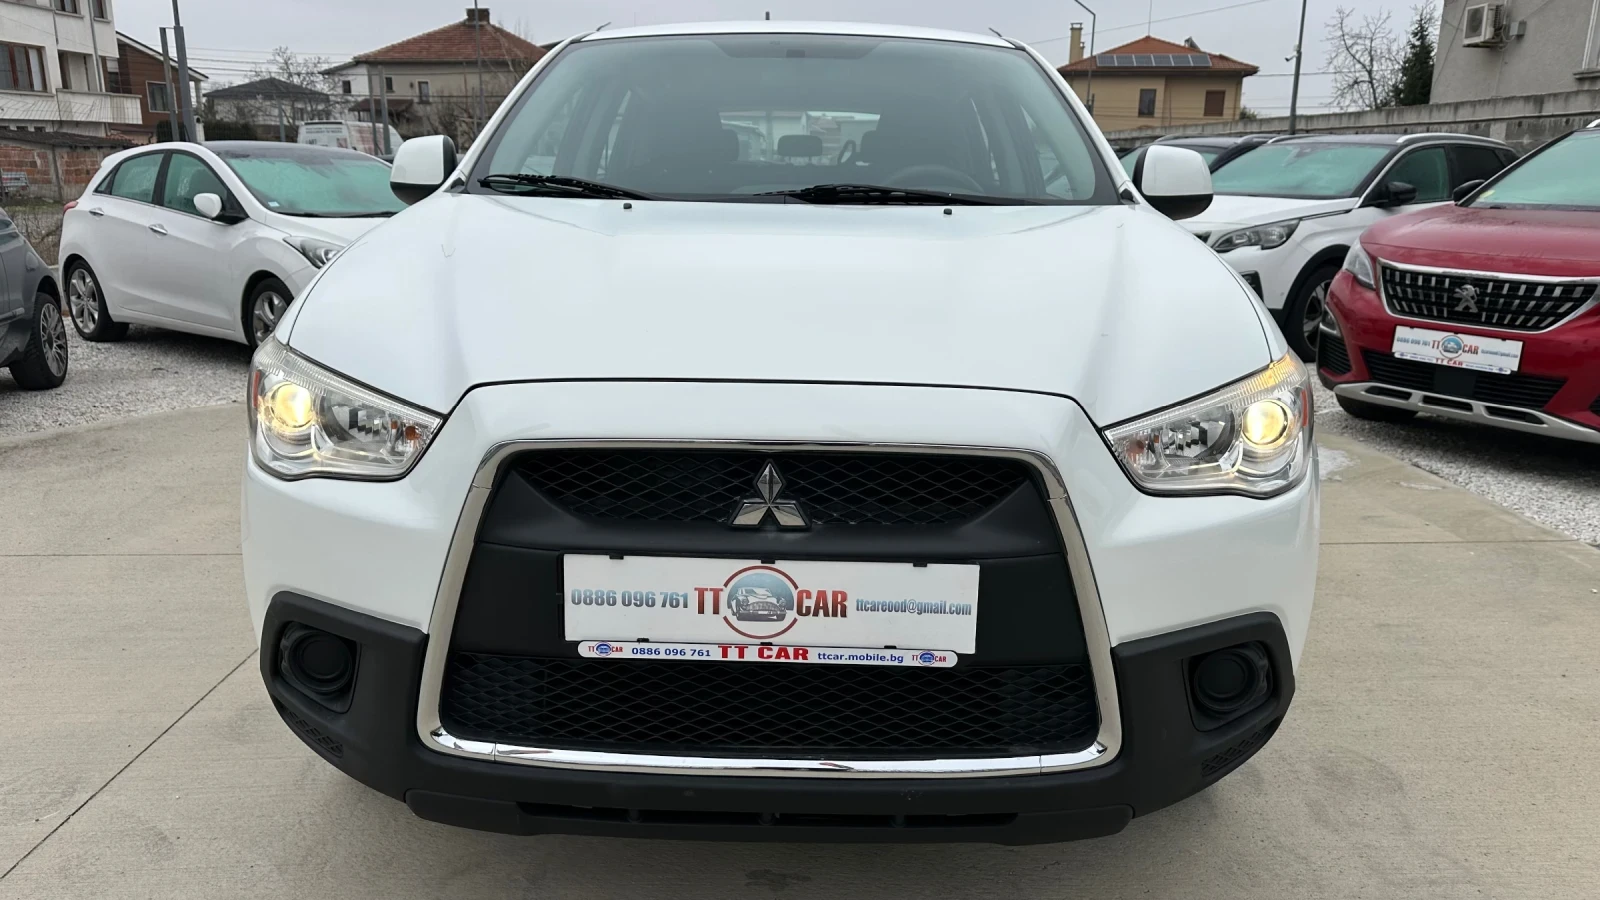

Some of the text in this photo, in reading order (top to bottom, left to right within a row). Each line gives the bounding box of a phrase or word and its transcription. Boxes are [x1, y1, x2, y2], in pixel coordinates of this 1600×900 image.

[1431, 340, 1441, 349] TT
[1462, 344, 1479, 355] CAR
[571, 588, 688, 609] 0886 096 761
[694, 587, 848, 618] TT CAR
[855, 598, 972, 616] ttcareood@gmail.com
[588, 645, 595, 653] TT
[631, 647, 711, 657] 0886 096 761
[718, 645, 809, 661] TT CAR
[817, 652, 904, 664] ttcar.mobile.bg
[911, 654, 947, 663] TT CAR
